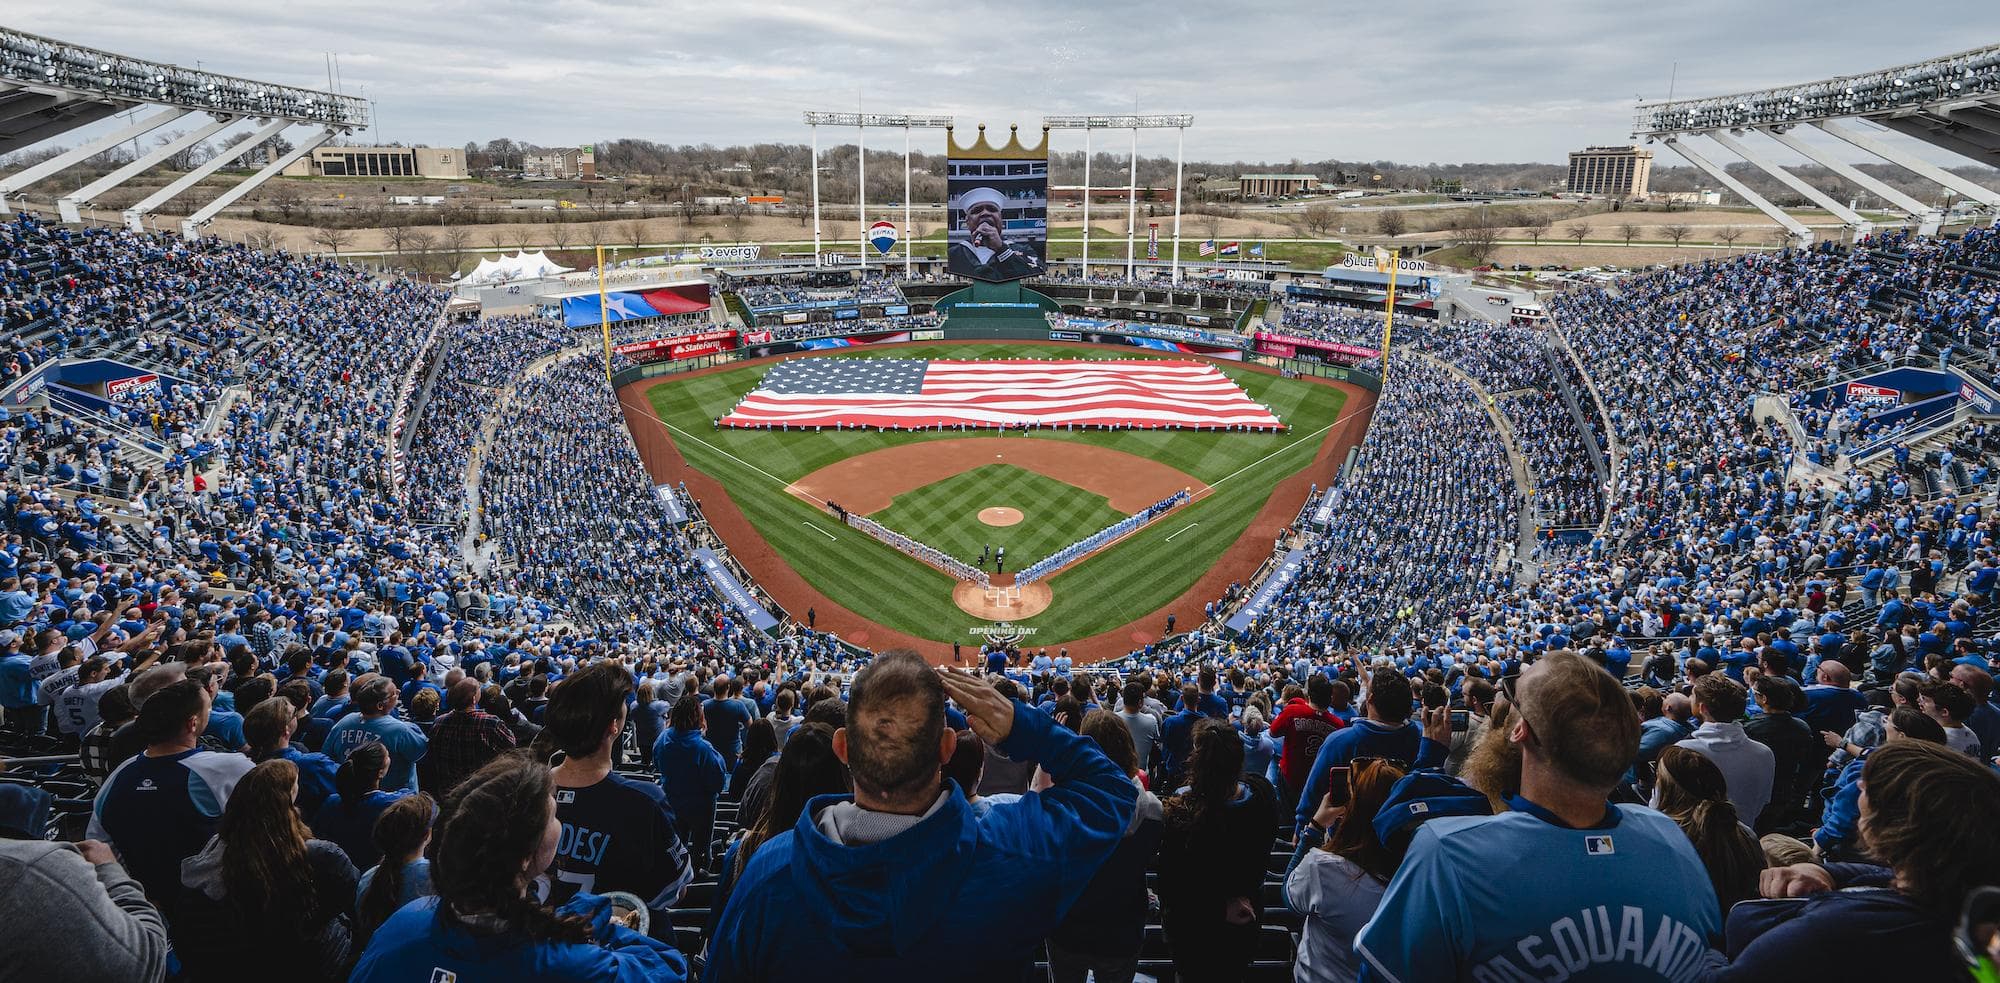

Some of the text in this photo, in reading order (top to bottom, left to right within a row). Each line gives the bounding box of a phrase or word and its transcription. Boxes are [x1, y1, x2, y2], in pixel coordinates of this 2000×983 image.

[716, 246, 760, 259] evergy
[824, 252, 844, 266] Lite
[1343, 253, 1374, 267] BLUE
[1226, 269, 1258, 280] PATIO
[508, 286, 520, 294] 42
[1149, 327, 1193, 337] PEPSI PORCH
[112, 378, 139, 392] PRICE
[113, 381, 157, 401] CHPPER
[969, 627, 1038, 635] OPENING DAY
[69, 708, 86, 726] 5
